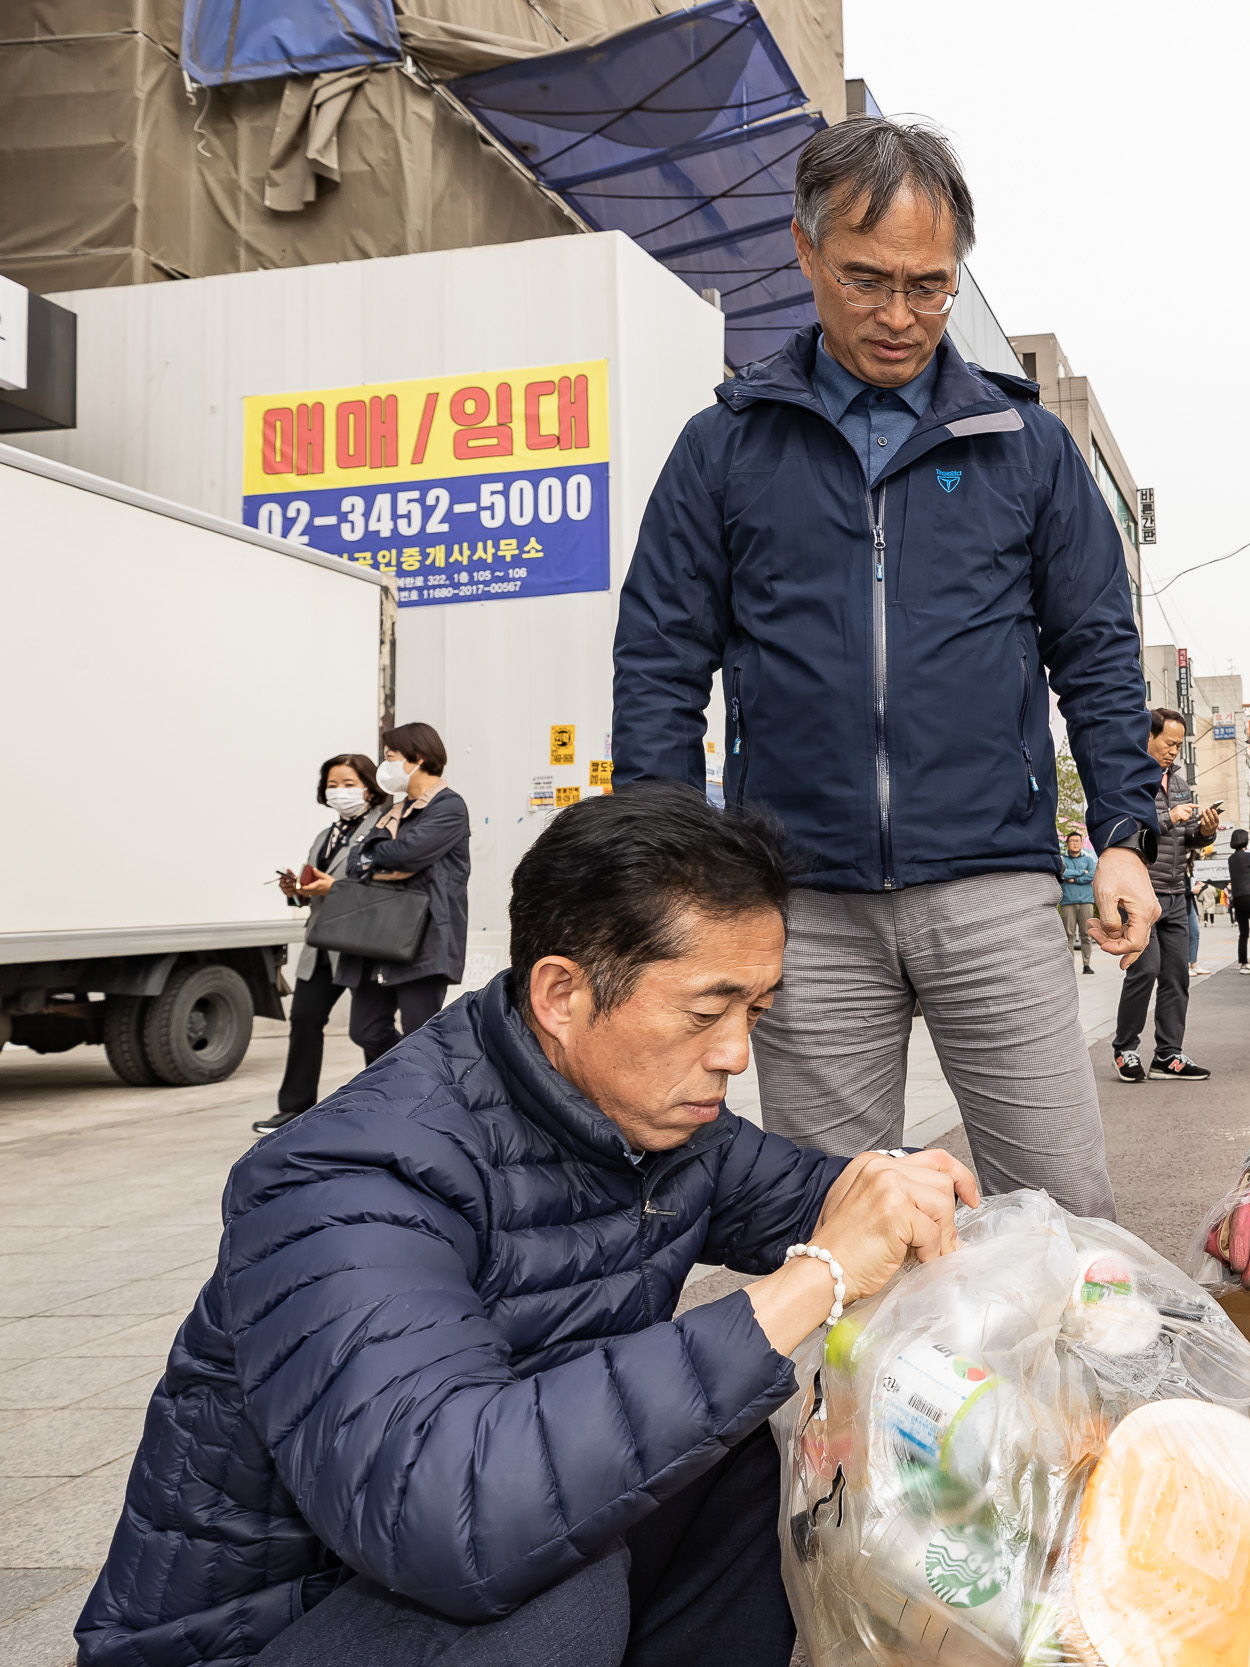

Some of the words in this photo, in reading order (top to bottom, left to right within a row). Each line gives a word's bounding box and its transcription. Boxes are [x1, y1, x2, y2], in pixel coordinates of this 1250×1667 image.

[263, 374, 589, 475] 매매/임대
[257, 474, 592, 545] 02-3452-5000
[333, 537, 545, 572] 공인중개사사무소
[473, 570, 491, 582] 105
